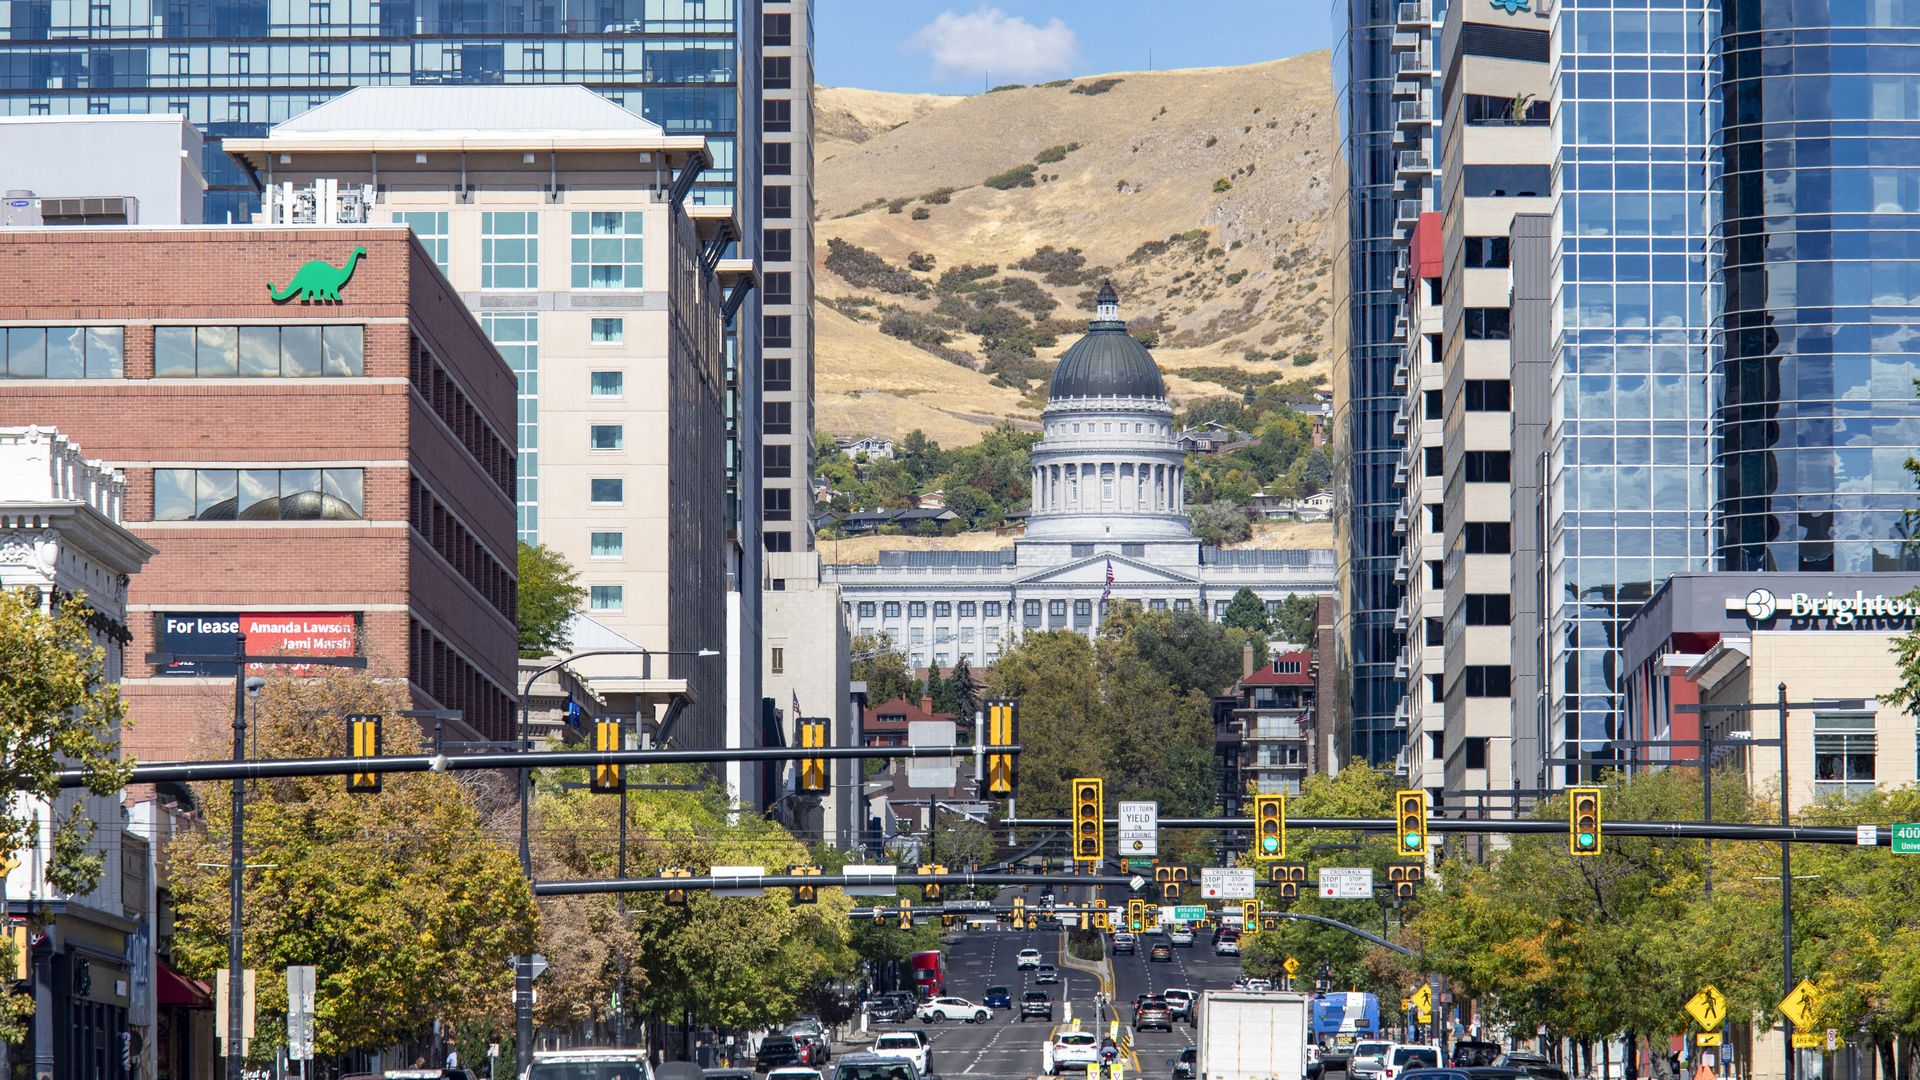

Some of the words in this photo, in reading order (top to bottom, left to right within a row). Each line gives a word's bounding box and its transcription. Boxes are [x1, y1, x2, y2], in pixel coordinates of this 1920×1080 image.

[167, 619, 194, 634] For
[198, 619, 239, 634] lease
[250, 622, 300, 634] Amanda
[304, 622, 350, 634] Lawson
[282, 637, 311, 650] Jami
[1127, 814, 1150, 823] YIELD
[1897, 827, 1920, 839] 400
